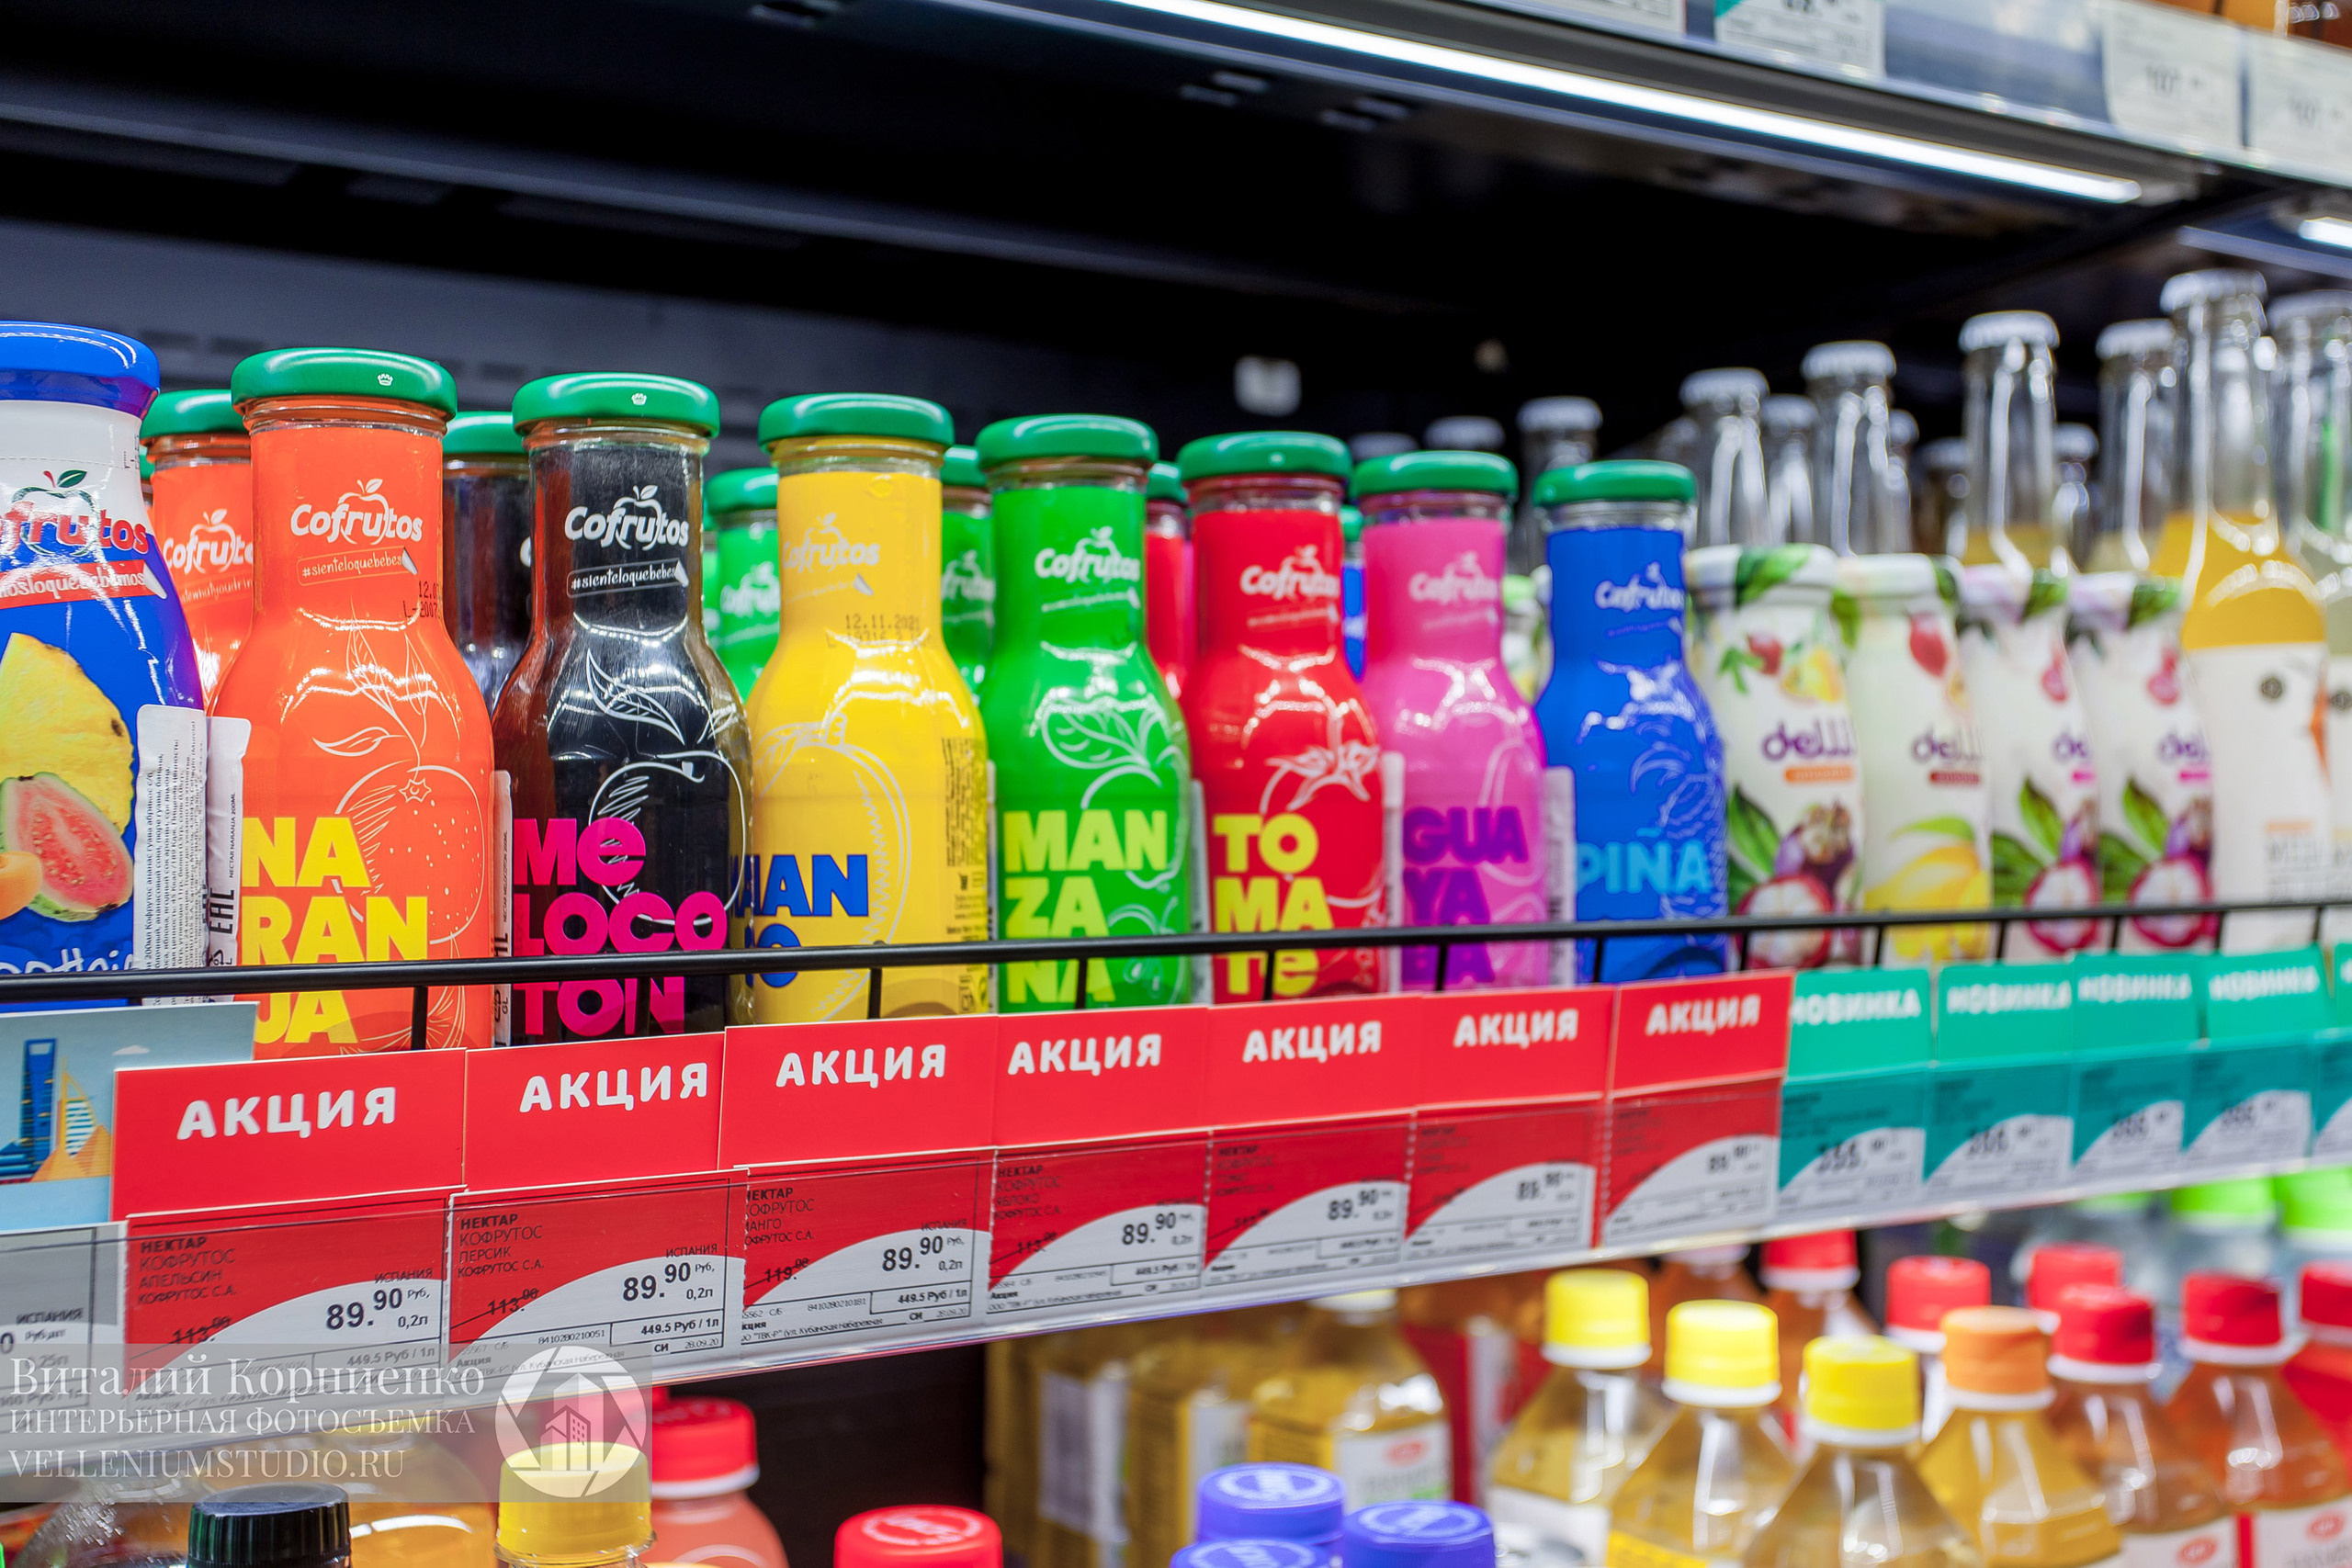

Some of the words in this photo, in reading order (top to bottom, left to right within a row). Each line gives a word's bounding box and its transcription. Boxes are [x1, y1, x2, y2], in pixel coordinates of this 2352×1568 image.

[0, 501, 149, 555] frutos
[290, 502, 424, 544] Cofrutos
[564, 506, 689, 549] Cofrutos
[1003, 809, 1168, 872] MAN
[1213, 813, 1318, 874] TO
[1402, 806, 1529, 865] GUA
[243, 817, 371, 887] NA
[1004, 875, 1110, 937] ZA
[1214, 877, 1334, 933] MA
[1402, 868, 1492, 928] YA
[513, 891, 727, 955] LOCO
[1645, 994, 1761, 1036] АКЦИЯ
[1453, 1008, 1579, 1050] АКЦИЯ
[1242, 1021, 1382, 1064] АКЦИЯ
[775, 1043, 945, 1089] АКЦИЯ
[1007, 1033, 1162, 1077] АКЦИЯ
[519, 1062, 707, 1113] АКЦИЯ
[176, 1087, 397, 1140] АКЦИЯ
[998, 1165, 1044, 1178] НЕКТАР
[747, 1199, 815, 1216] ОФРУТОС
[460, 1213, 518, 1230] НЕКТАР
[921, 1218, 967, 1232] ИСПАНИЯ
[140, 1236, 208, 1254] НЕКТАР
[459, 1225, 544, 1247] КОФРУТОС
[744, 1232, 793, 1246] ОФРУТОС
[139, 1249, 236, 1271] КОФРУТОС
[459, 1246, 512, 1263] ПЕРСИК
[665, 1243, 718, 1258] ИСПАНИЯ
[375, 1268, 434, 1284] ИСПАНИЯ
[458, 1260, 518, 1278] КОФРУТОС
[522, 1258, 545, 1271] С.А.
[138, 1269, 223, 1290] АПЕЛЬСИН
[137, 1287, 209, 1305] КОФРУТОС
[685, 1287, 714, 1301] 0,2л
[16, 1308, 84, 1325] ИСПАНИЯ
[397, 1314, 429, 1329] 0,2л
[640, 1321, 673, 1337] 449.5
[673, 1320, 698, 1334] Руб
[706, 1316, 720, 1328] 1л
[741, 1320, 766, 1331] кция
[384, 1348, 411, 1364] Руб
[653, 1342, 670, 1354] СИ
